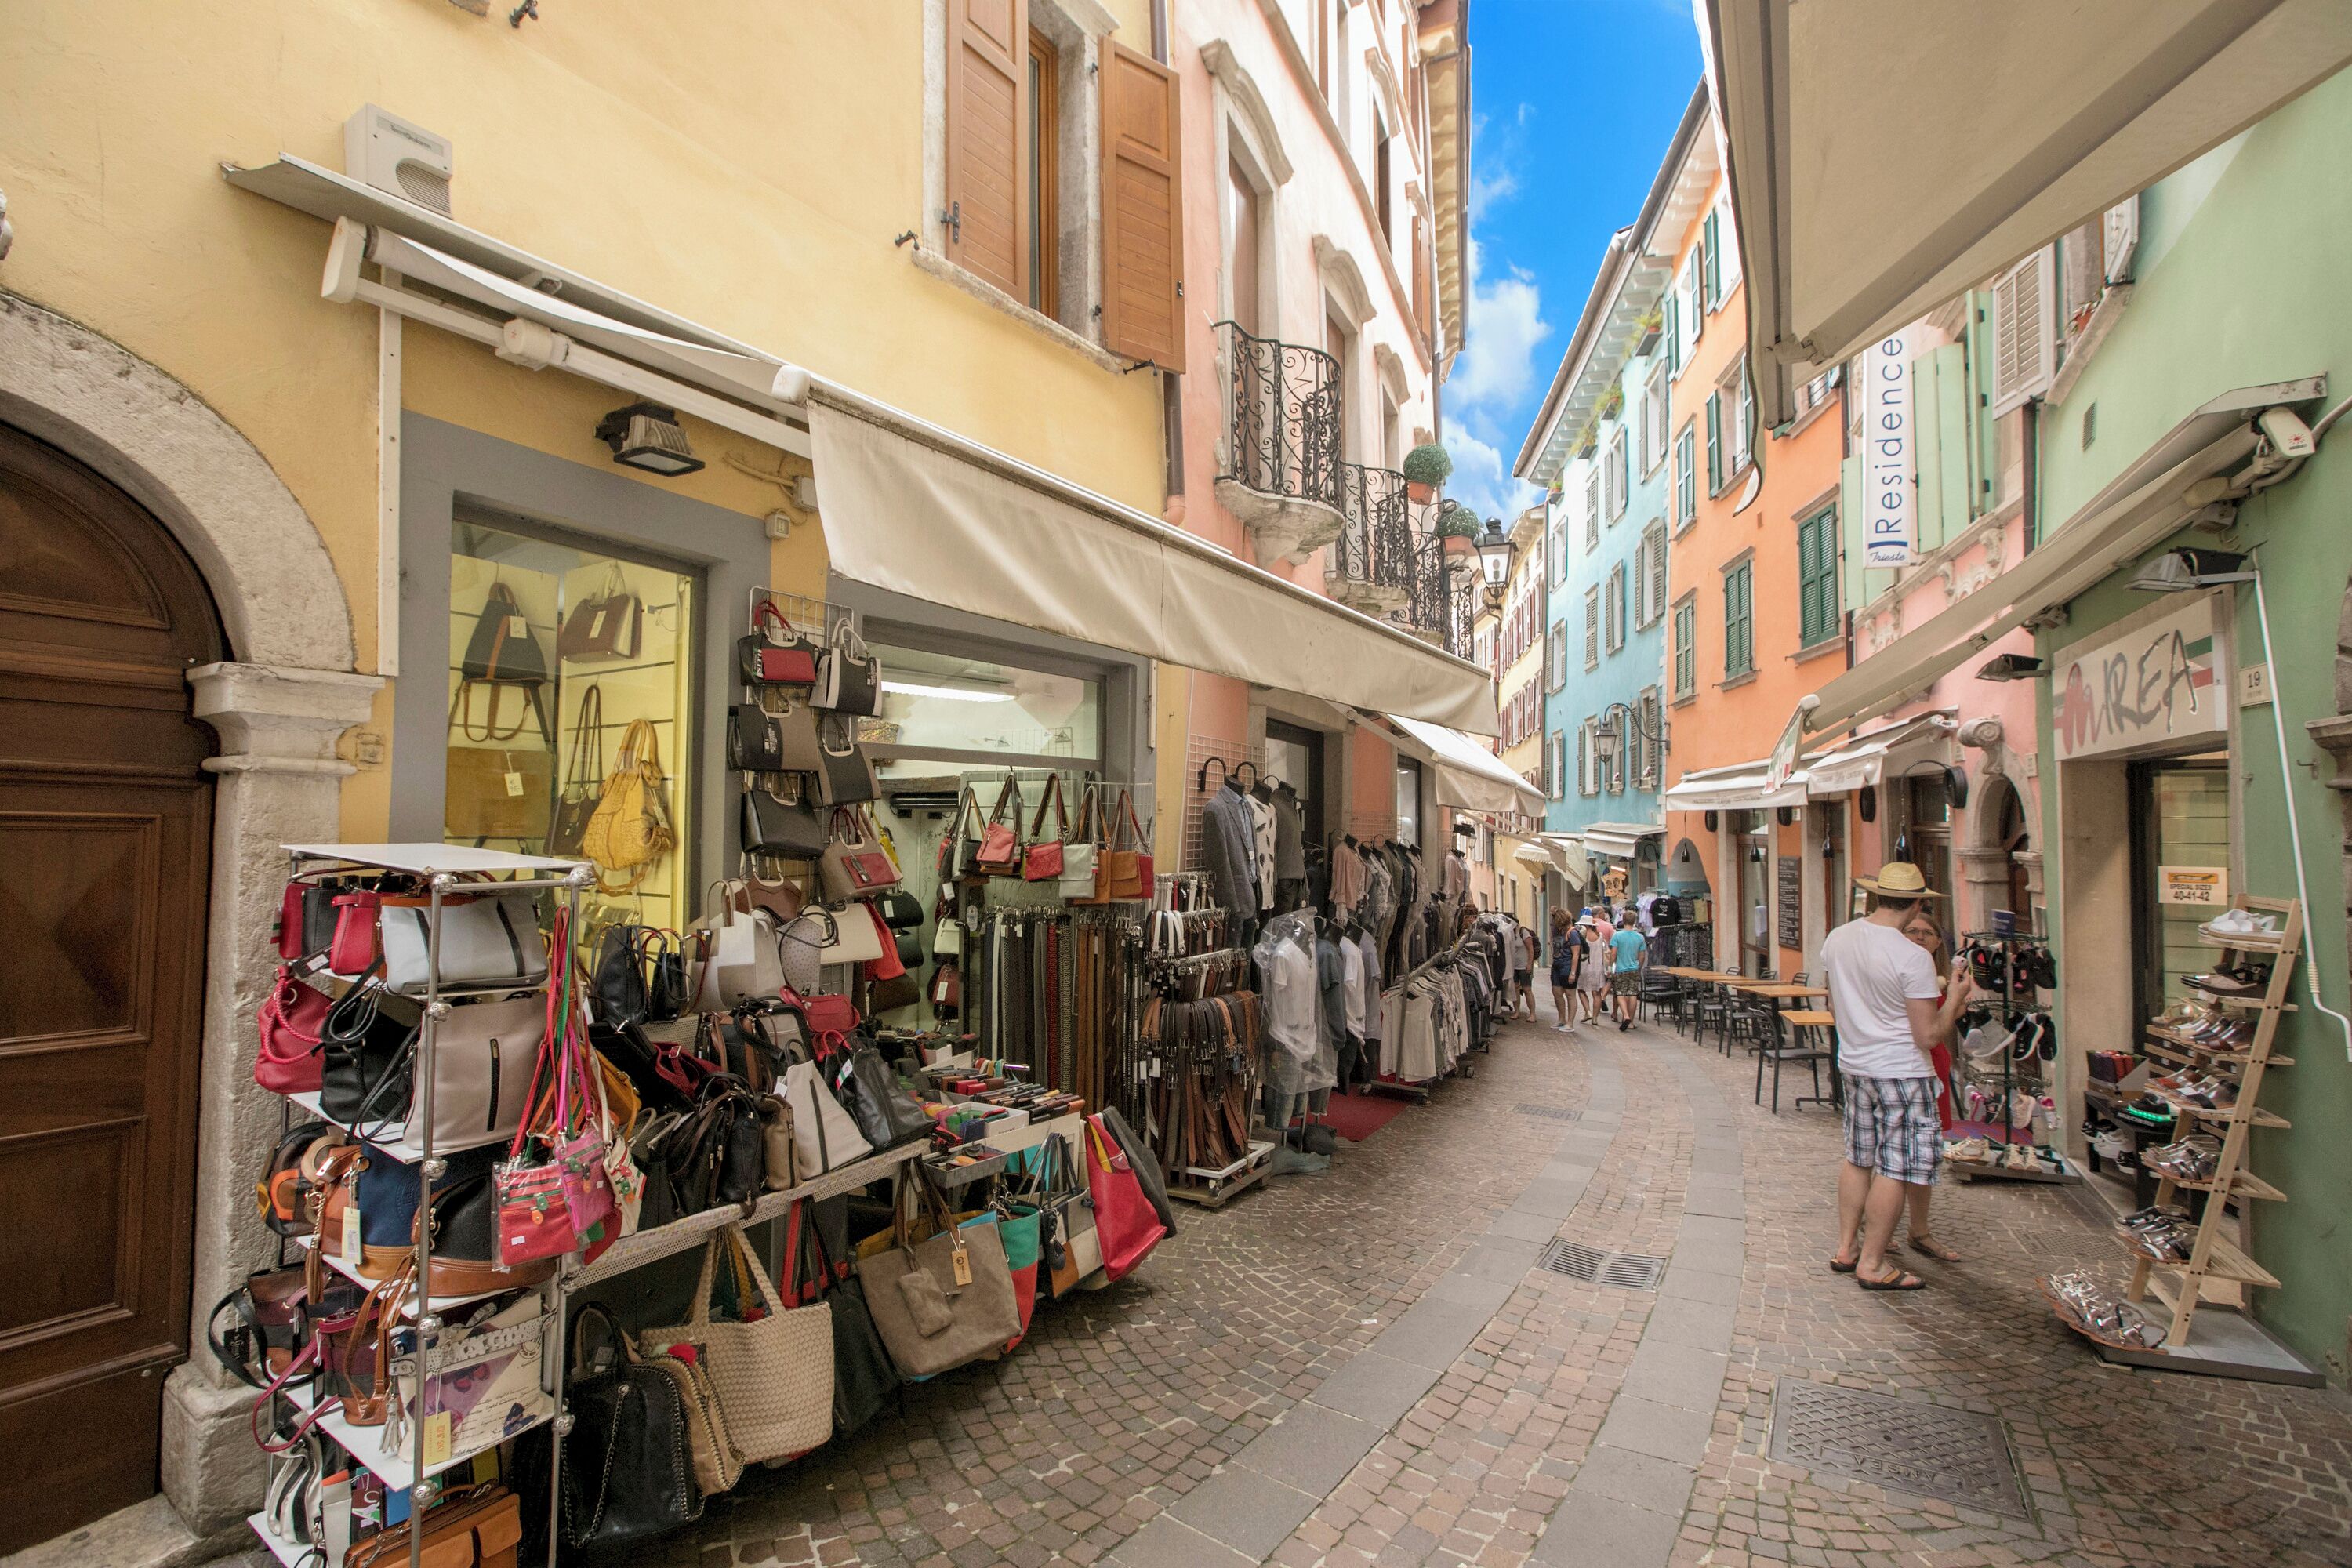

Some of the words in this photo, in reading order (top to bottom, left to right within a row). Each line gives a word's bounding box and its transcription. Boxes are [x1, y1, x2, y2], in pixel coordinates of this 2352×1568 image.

[1875, 339, 1903, 534] Residence
[1869, 551, 1906, 563] Trieste
[2248, 671, 2260, 688] 19
[2173, 891, 2210, 902] 40-41-42
